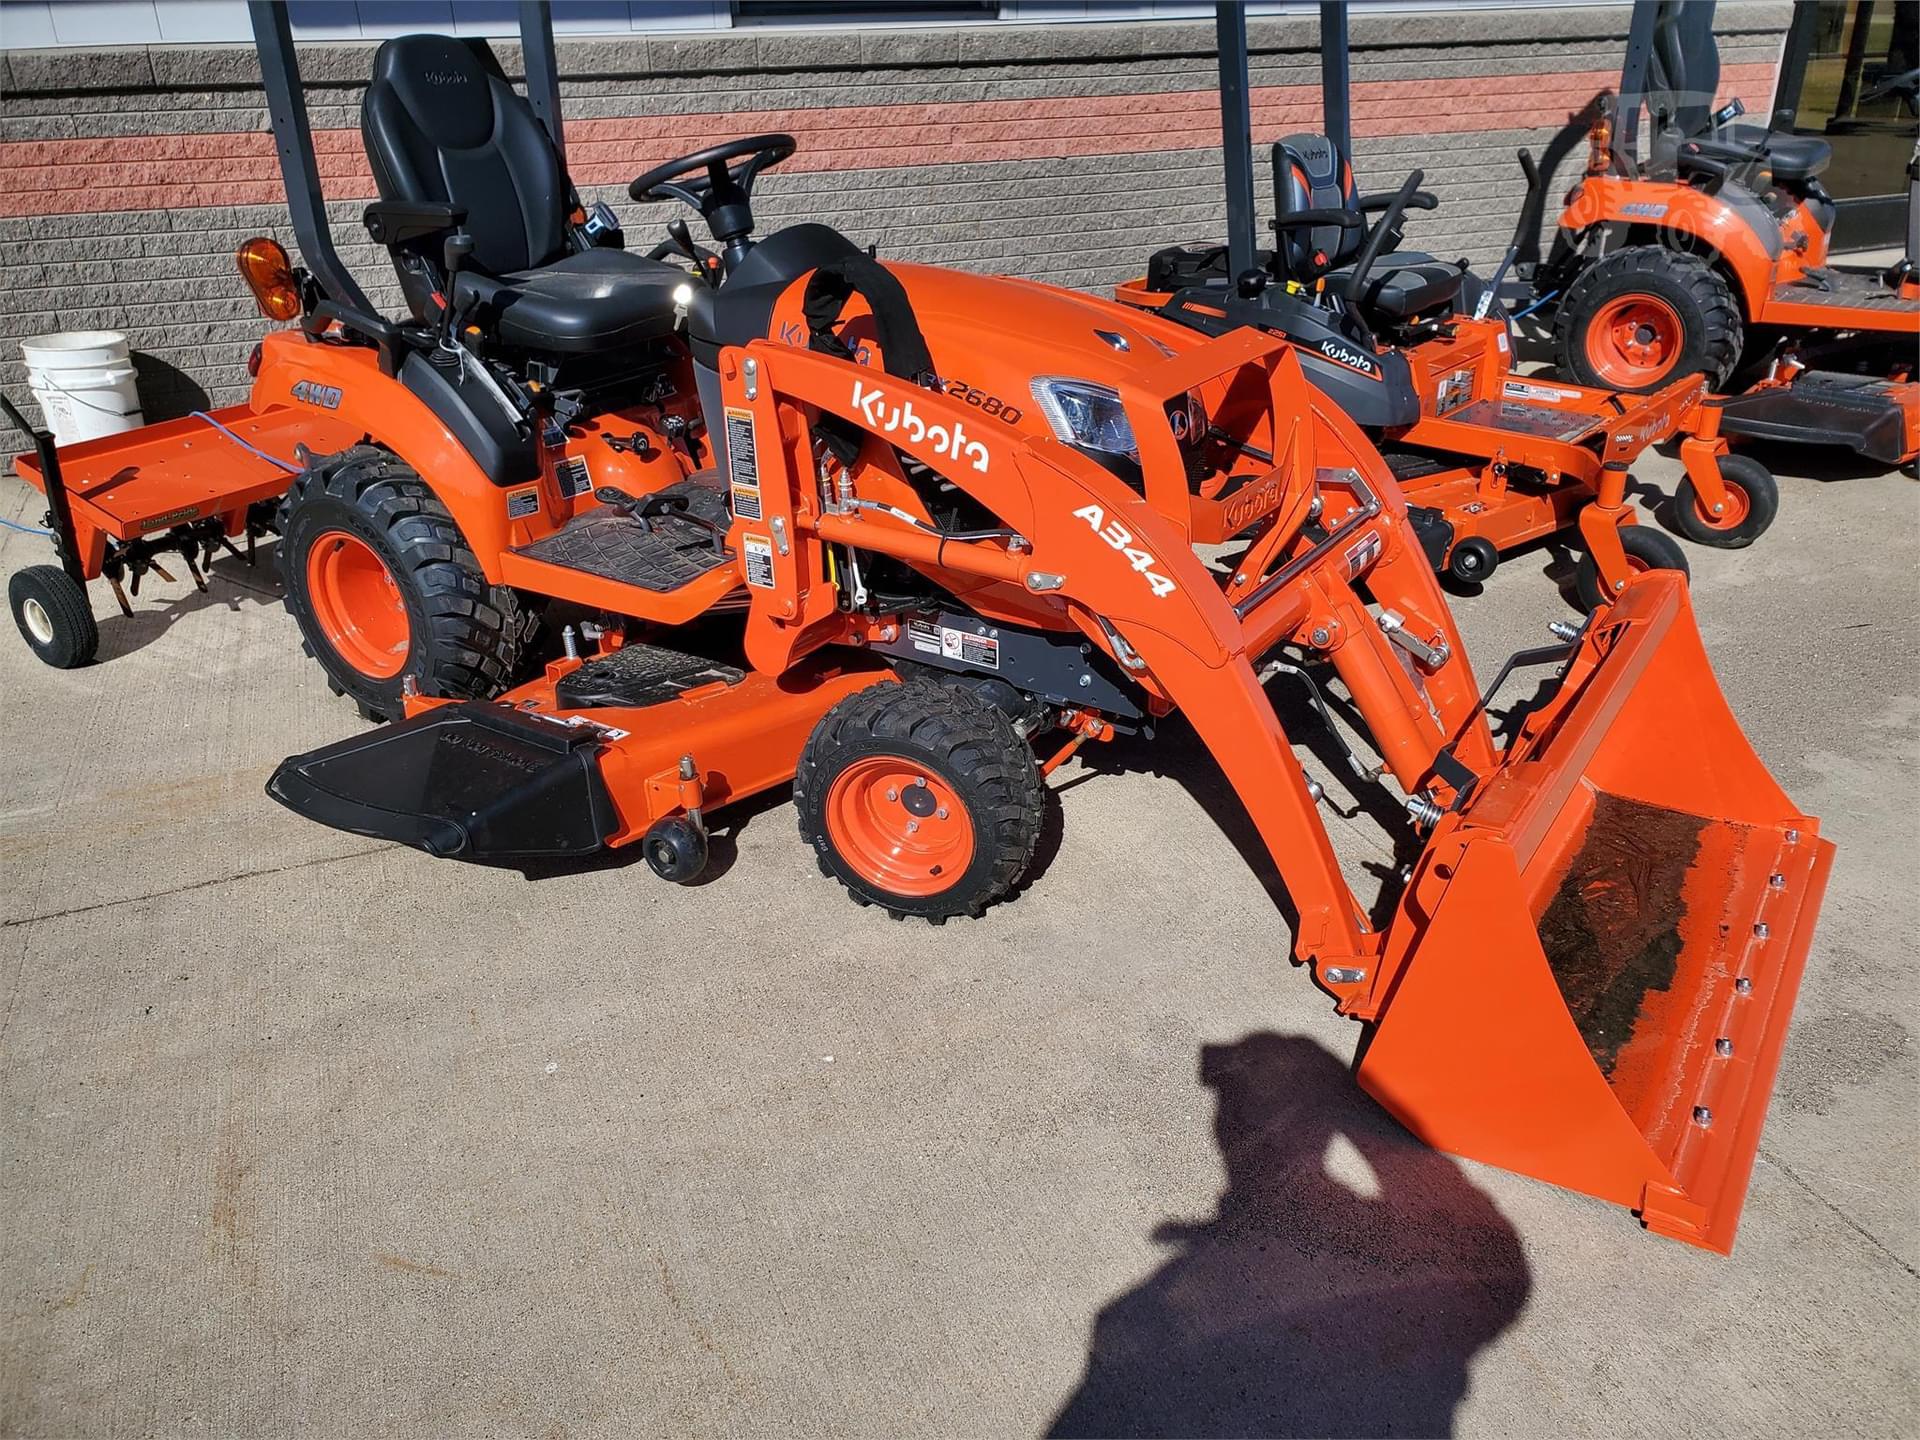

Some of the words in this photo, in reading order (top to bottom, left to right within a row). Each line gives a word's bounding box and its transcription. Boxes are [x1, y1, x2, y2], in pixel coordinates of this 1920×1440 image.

[1320, 340, 1372, 372] Kubota
[291, 379, 344, 410] 4WD
[851, 379, 990, 473] Kubota
[1222, 480, 1279, 530] Kubota
[1071, 503, 1177, 599] A344
